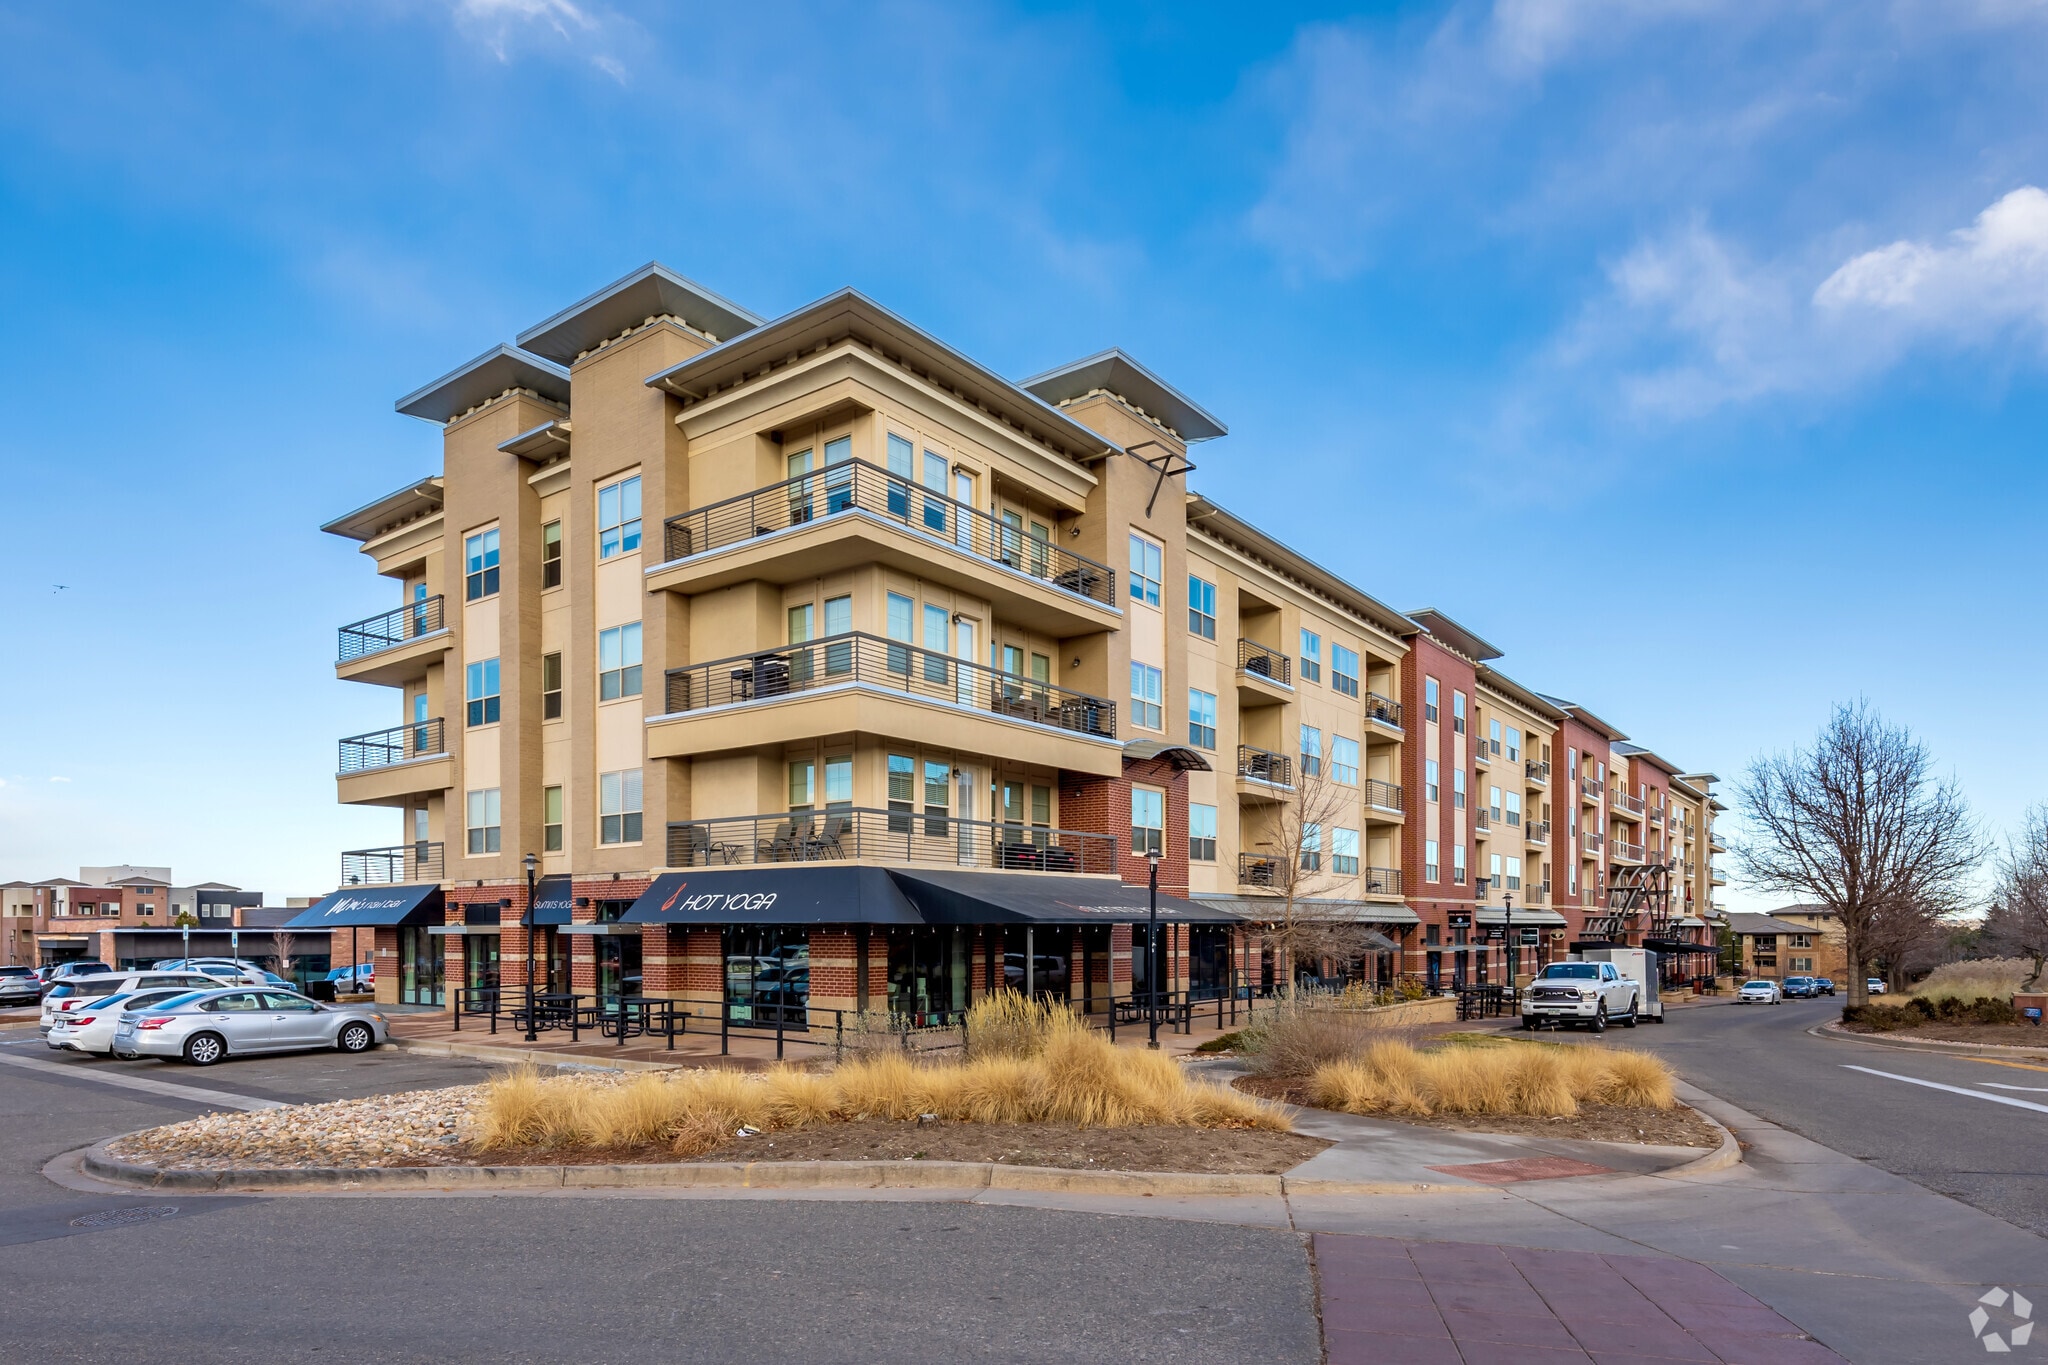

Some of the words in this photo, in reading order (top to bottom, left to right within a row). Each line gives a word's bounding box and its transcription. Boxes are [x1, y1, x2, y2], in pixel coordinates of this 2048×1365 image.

[381, 899, 407, 909] bar
[557, 900, 572, 909] YOG
[679, 894, 724, 911] HOT
[720, 893, 778, 911] YOGA
